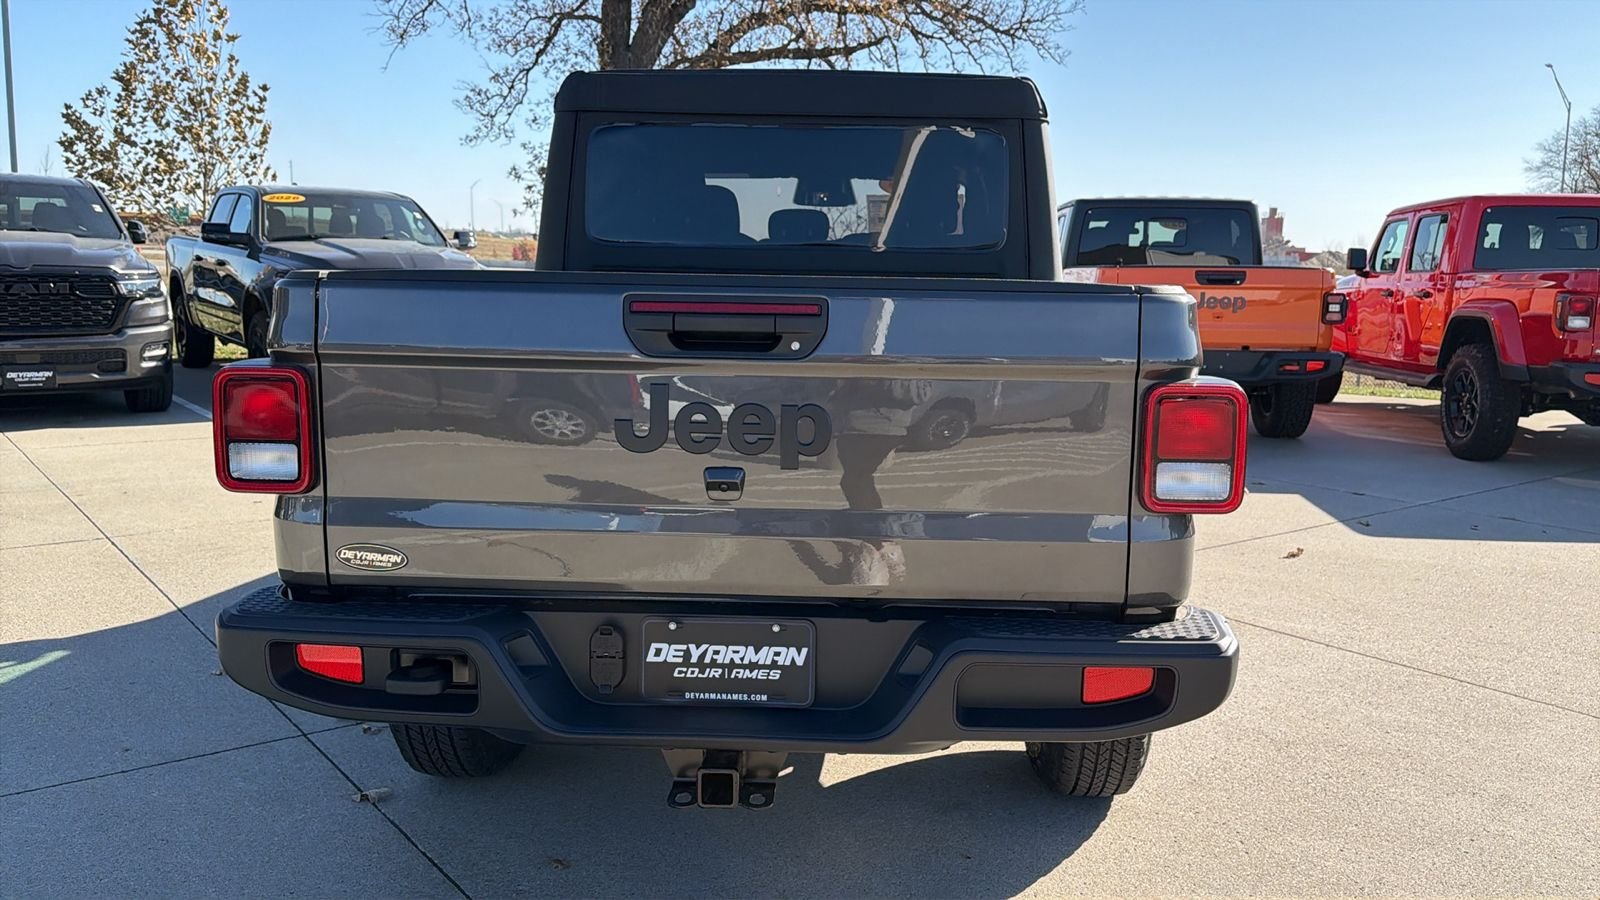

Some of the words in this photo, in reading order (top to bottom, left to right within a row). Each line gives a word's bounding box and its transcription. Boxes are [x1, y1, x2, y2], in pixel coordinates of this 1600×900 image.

[0, 282, 70, 294] AM
[1197, 291, 1247, 314] Jeep
[614, 383, 833, 470] Jeep
[340, 549, 402, 563] DEYARMAN
[646, 642, 809, 667] DEYARMAN
[673, 667, 722, 679] CDJR
[730, 668, 782, 680] AMES
[685, 692, 768, 702] DEYARMANAMES.COM
